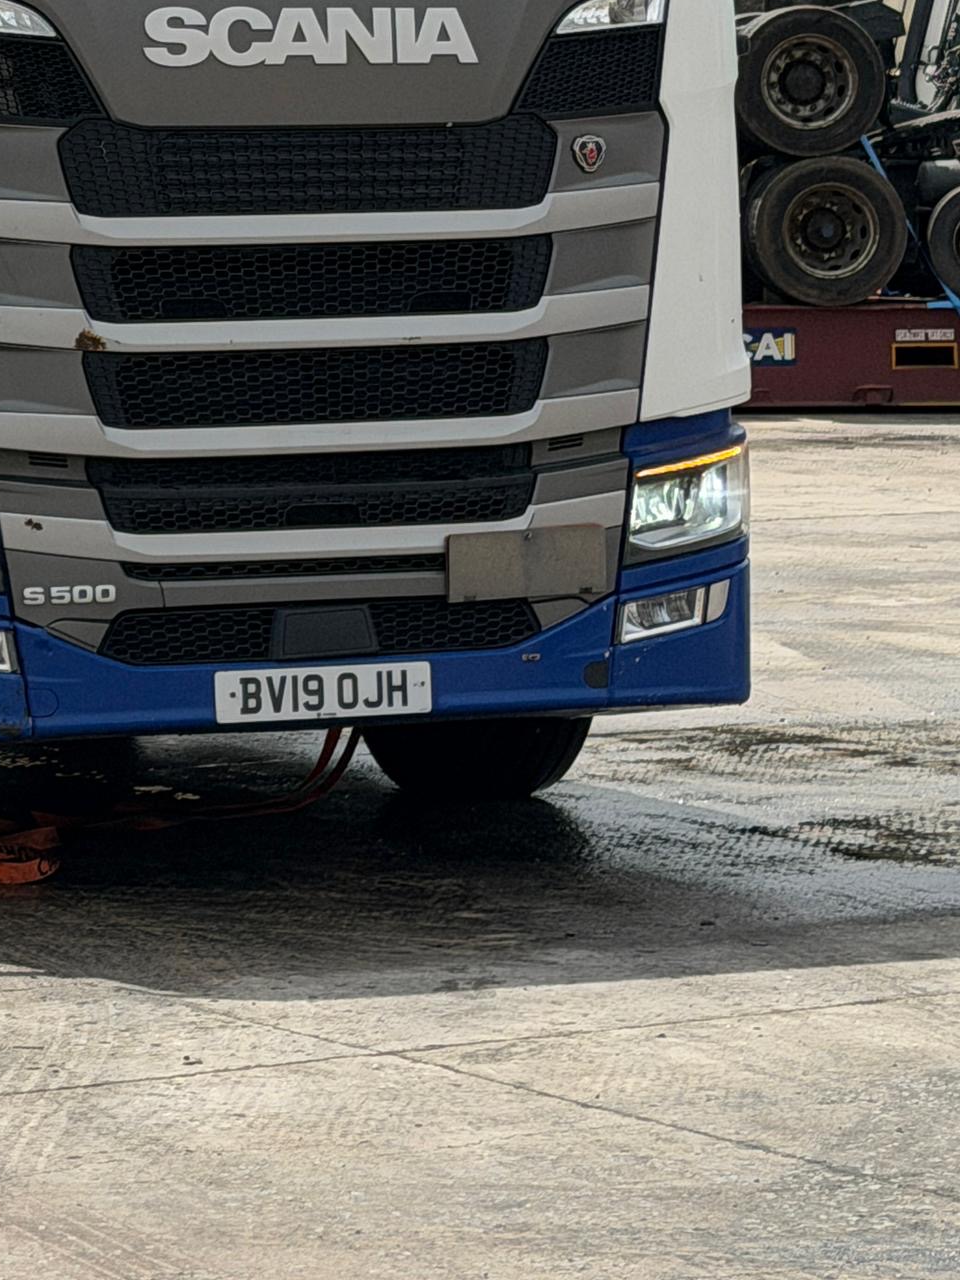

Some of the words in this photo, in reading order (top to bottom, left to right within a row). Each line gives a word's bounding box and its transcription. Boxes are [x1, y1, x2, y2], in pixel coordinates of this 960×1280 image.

[143, 6, 479, 67] SCANIA
[23, 586, 45, 606] S
[50, 584, 117, 605] 500
[239, 673, 325, 716] BV19
[336, 669, 409, 711] OJH
